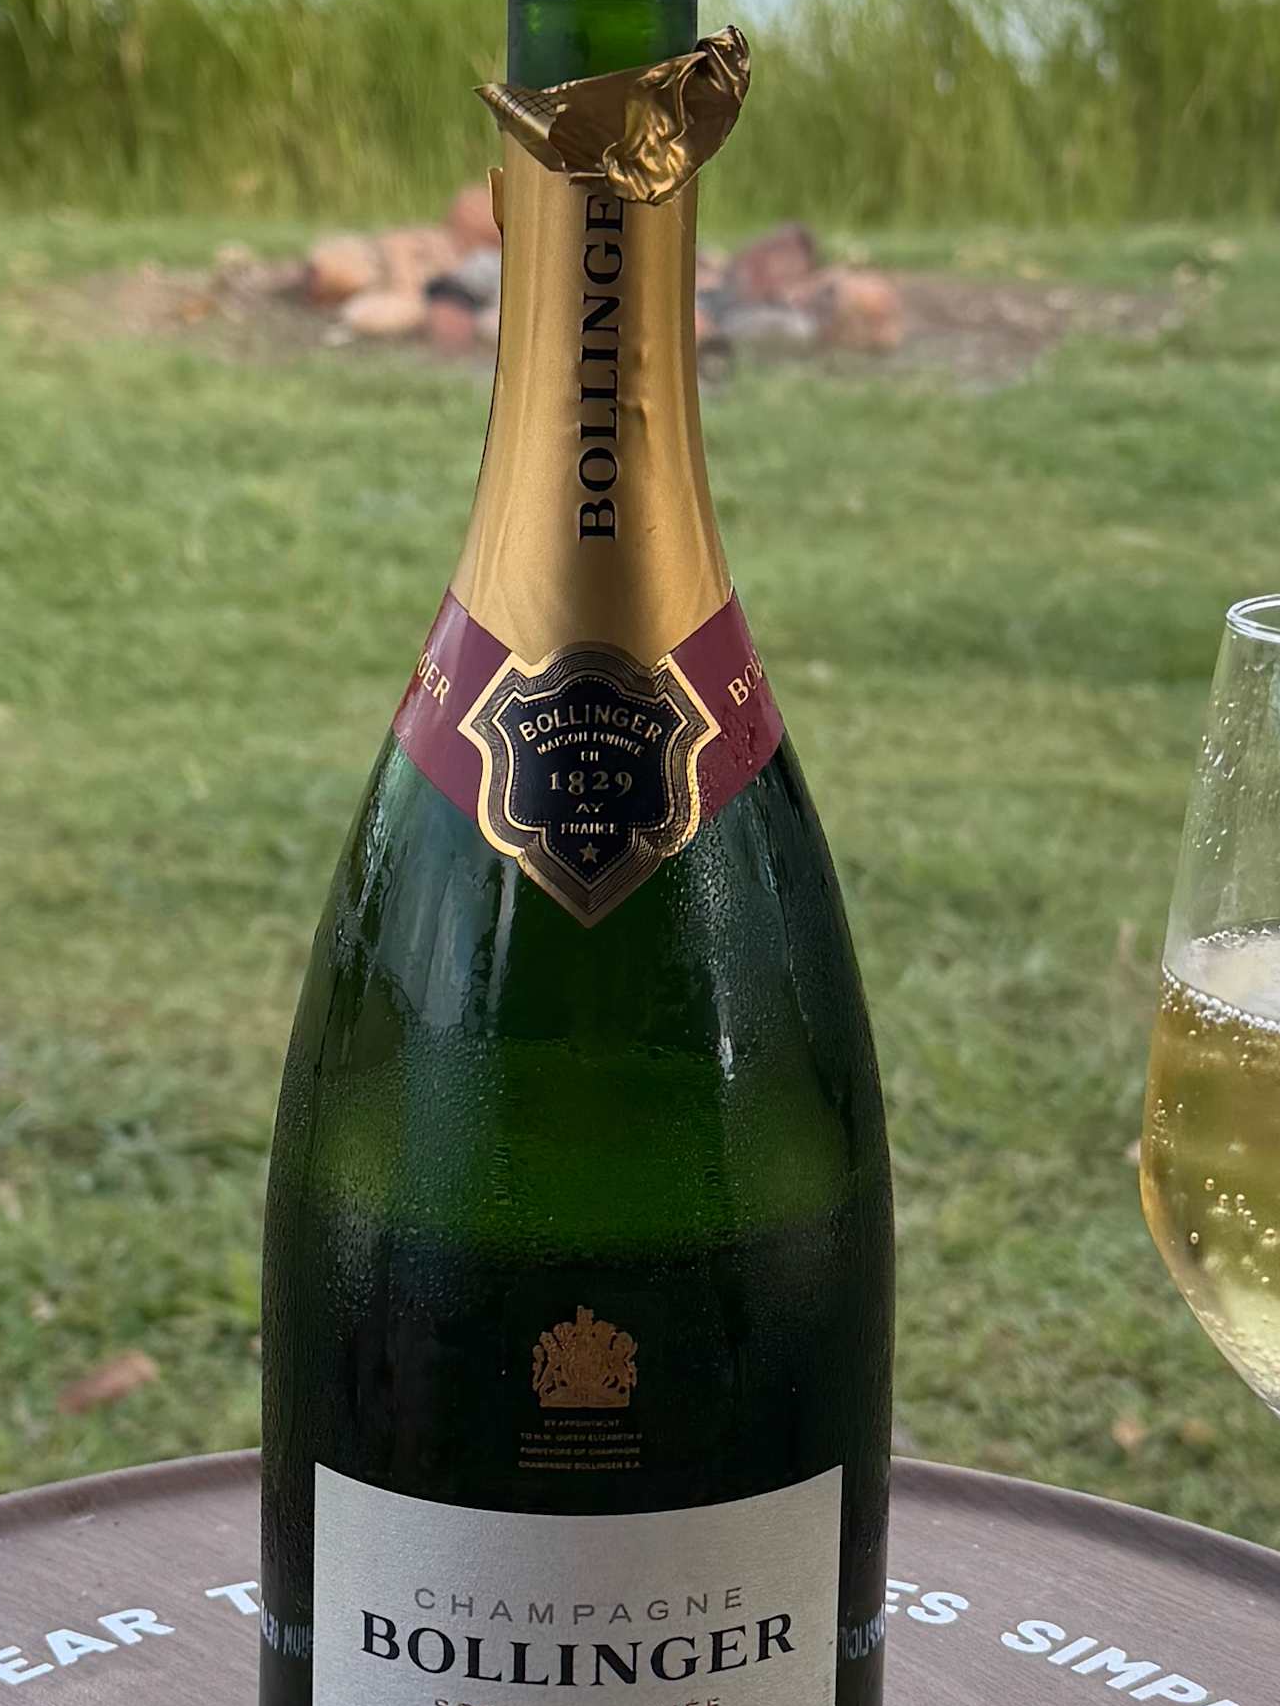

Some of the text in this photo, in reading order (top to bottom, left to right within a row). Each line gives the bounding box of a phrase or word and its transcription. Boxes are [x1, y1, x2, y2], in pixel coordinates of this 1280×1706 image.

[518, 704, 663, 743] BOLLINGER
[548, 771, 633, 798] 1829
[561, 822, 619, 835] FRANCE
[414, 1587, 743, 1625] CHAMPAGNE
[360, 1609, 796, 1687] BOLLINGER
